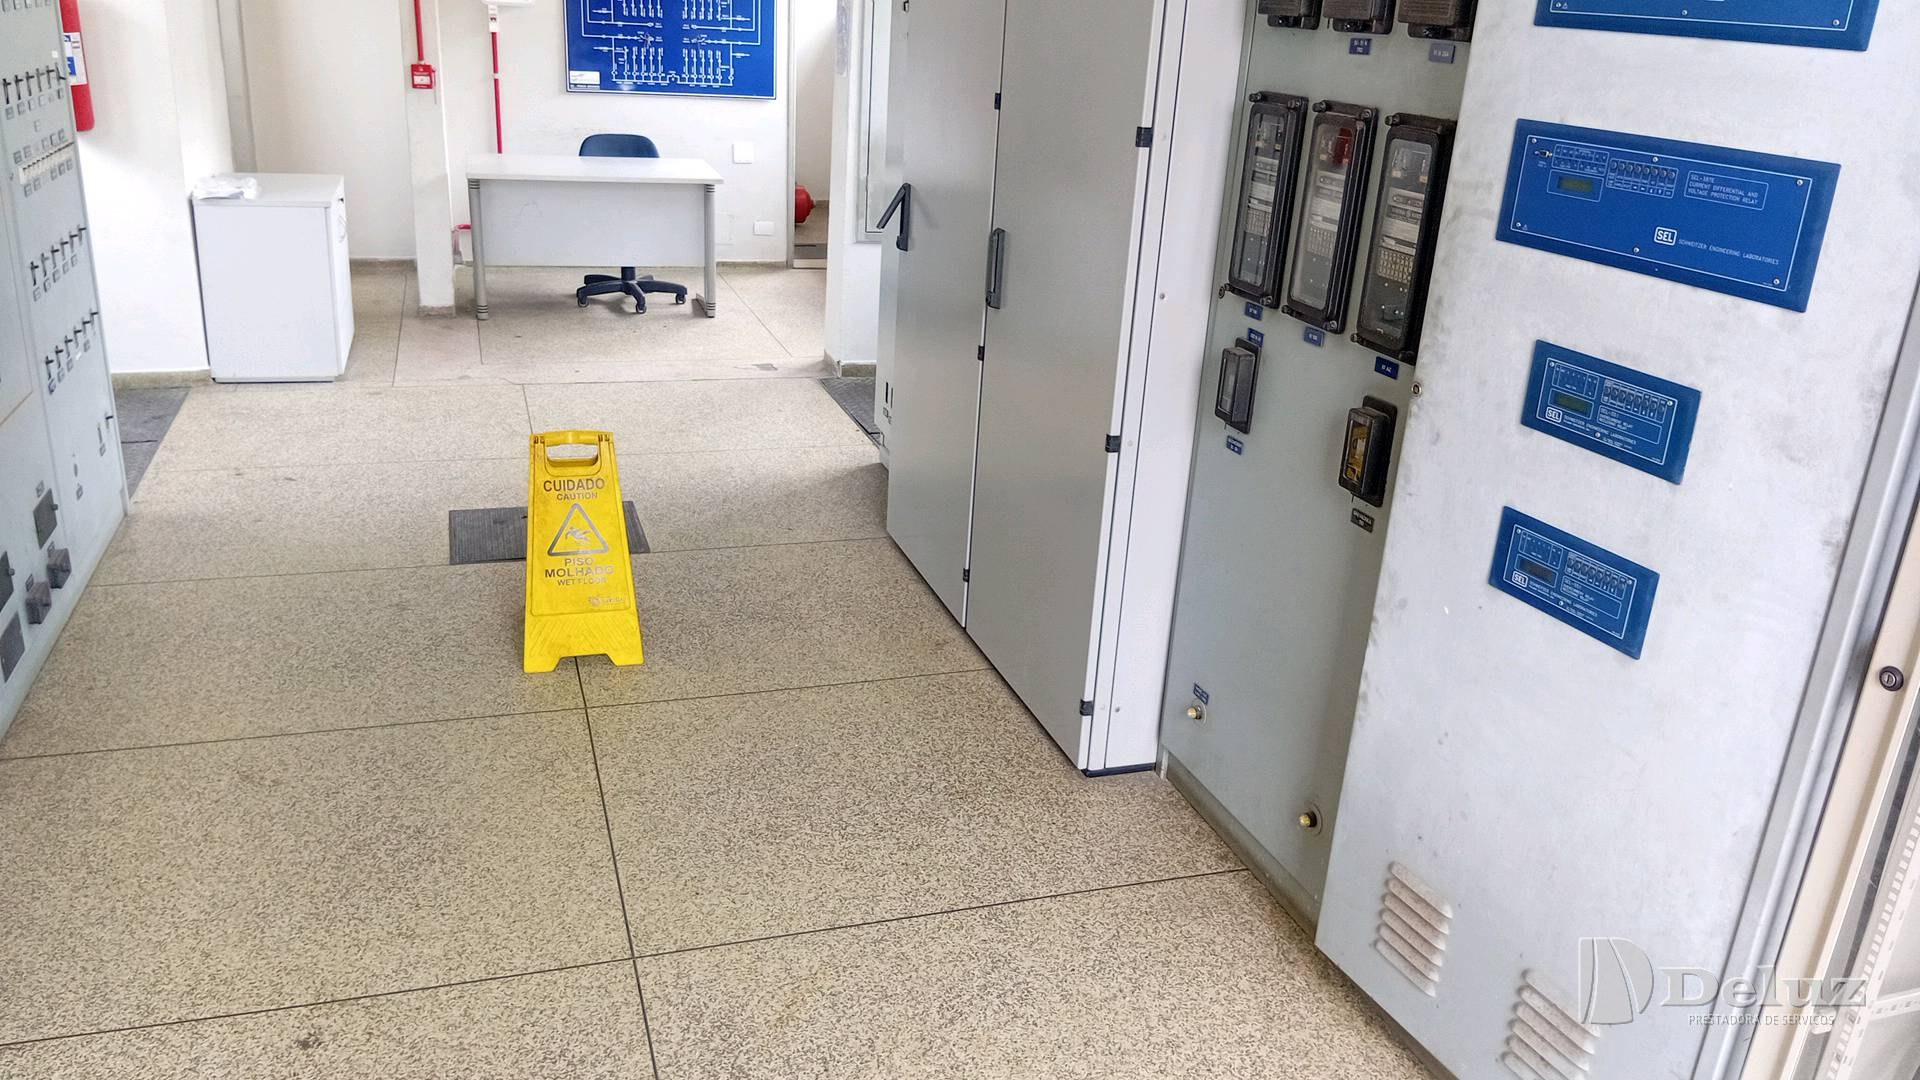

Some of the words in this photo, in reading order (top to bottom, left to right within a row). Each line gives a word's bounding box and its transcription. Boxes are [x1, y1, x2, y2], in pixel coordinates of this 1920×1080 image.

[1656, 230, 1673, 243] SEL
[1547, 409, 1560, 420] SEL
[543, 478, 605, 492] CUIDADO
[556, 492, 598, 501] CAUTION
[564, 557, 595, 567] PISO
[545, 565, 615, 578] MOLHADO
[557, 578, 576, 586] WET
[577, 576, 608, 585] FLOOR
[1513, 574, 1526, 585] SEL
